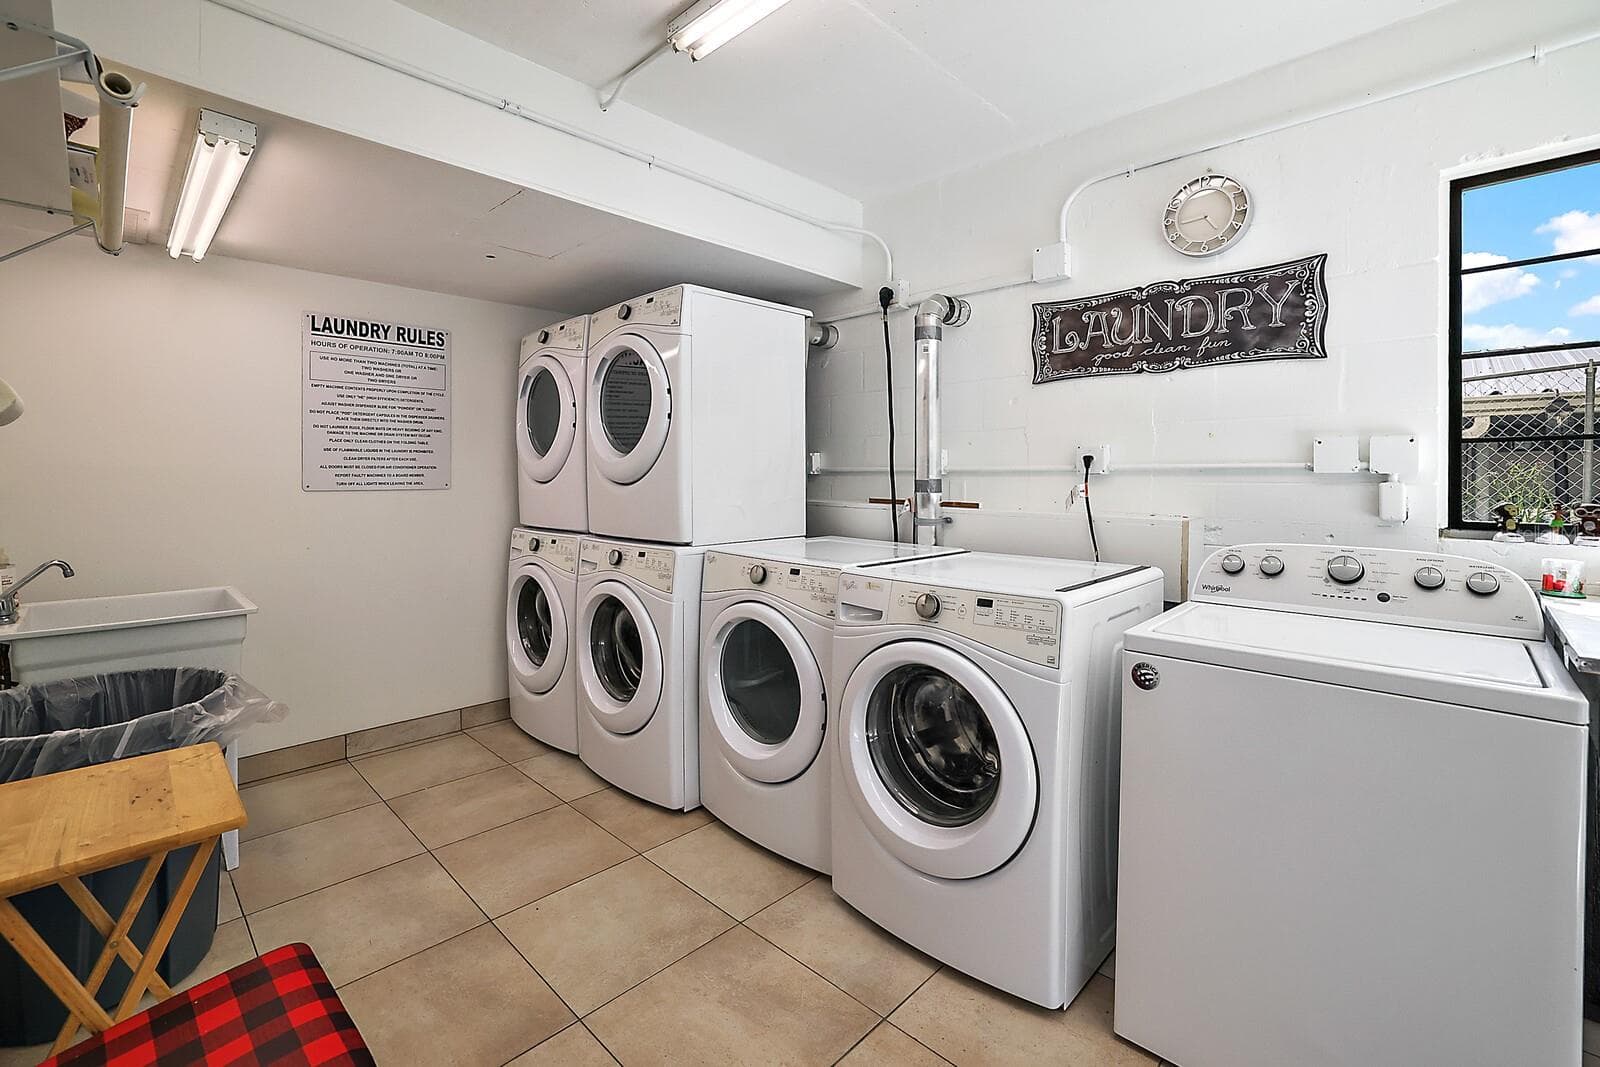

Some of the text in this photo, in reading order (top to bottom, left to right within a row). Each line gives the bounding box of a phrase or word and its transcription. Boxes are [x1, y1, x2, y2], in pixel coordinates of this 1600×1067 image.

[312, 315, 445, 347] LAUNDRY RULES
[1052, 280, 1301, 353] LAUNDRY
[311, 340, 336, 348] HOURS
[350, 344, 390, 354] OPERATION:
[1092, 336, 1232, 366] good clean fun
[1202, 584, 1231, 593] Whirlpool
